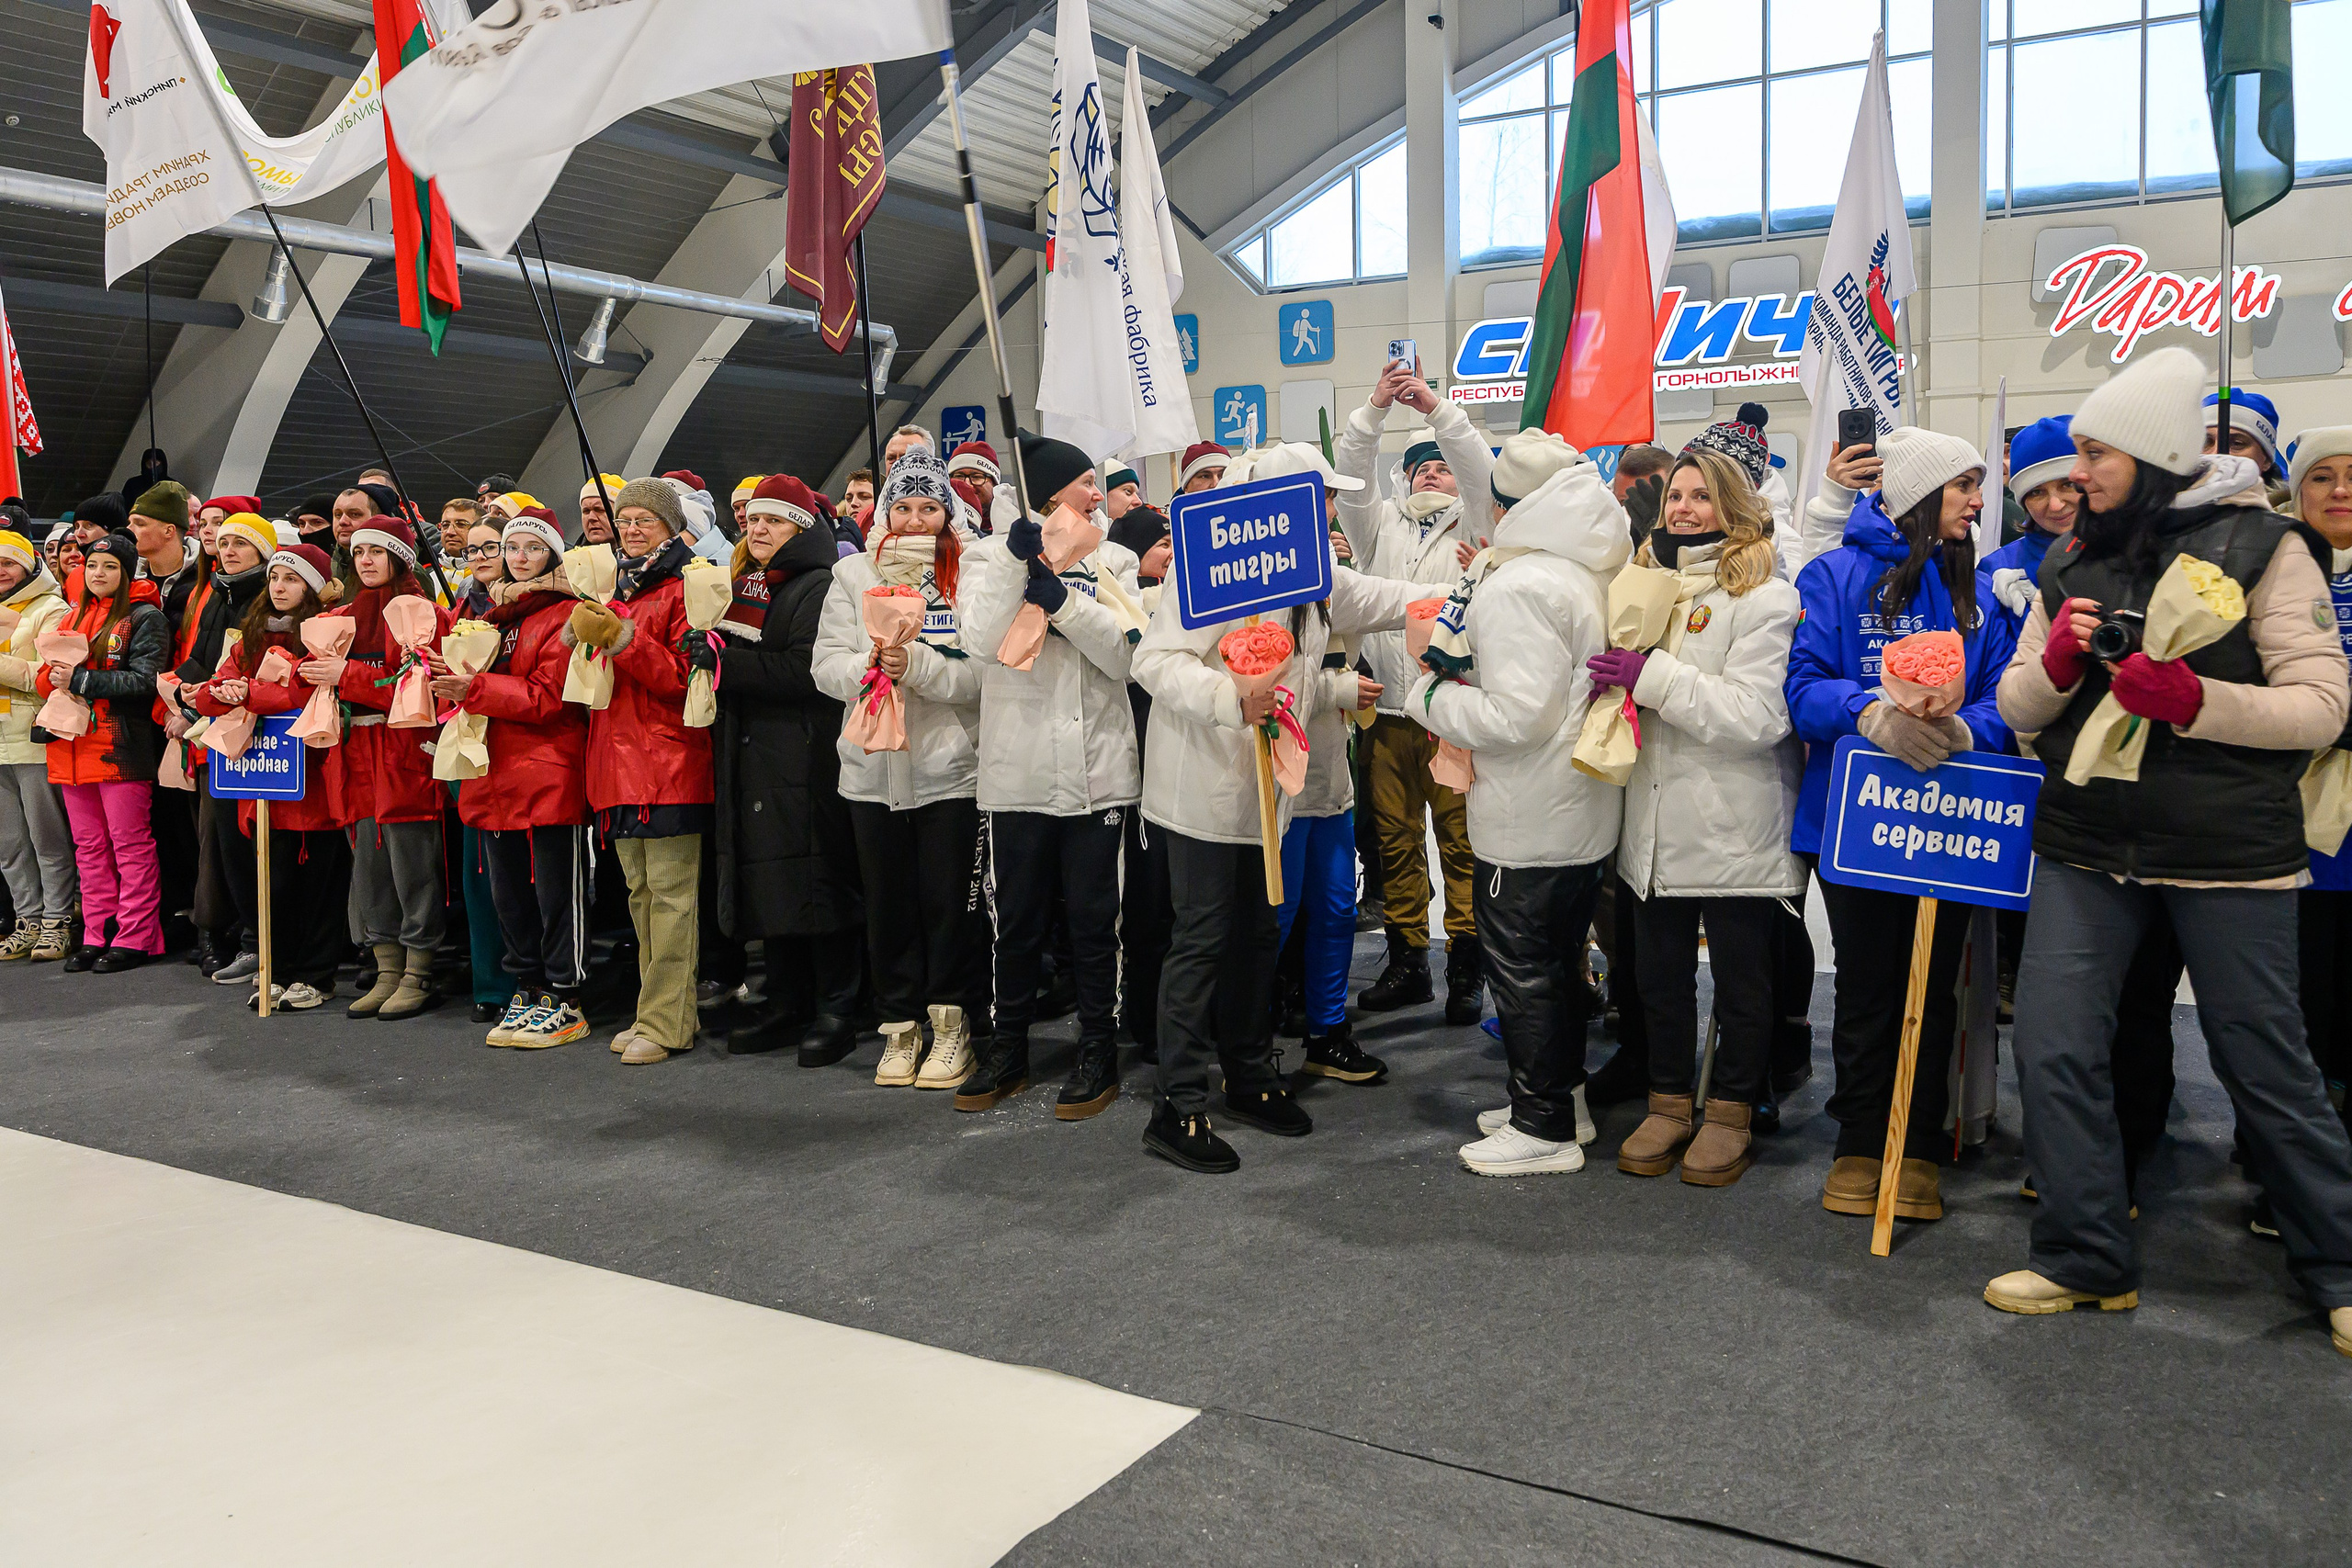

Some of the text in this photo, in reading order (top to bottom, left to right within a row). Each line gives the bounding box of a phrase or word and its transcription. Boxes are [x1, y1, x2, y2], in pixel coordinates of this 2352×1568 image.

[1832, 272, 1874, 346] БЕЛЫЕ
[1124, 304, 1157, 408] фабрика
[1812, 294, 1844, 345] КОМАНДА
[1838, 337, 1872, 403] РАБОТНИКОВ
[1452, 366, 1800, 400] РЕСПУБ ГОРНОЛЫЖН
[788, 511, 812, 528] БЕЛАР
[1209, 513, 1290, 550] Белые
[1209, 547, 1297, 588] тигры
[225, 751, 289, 778] народнае
[1857, 773, 2026, 828] Академия
[967, 809, 988, 912] STUDENT 2012
[1871, 821, 2001, 863] сервиса
